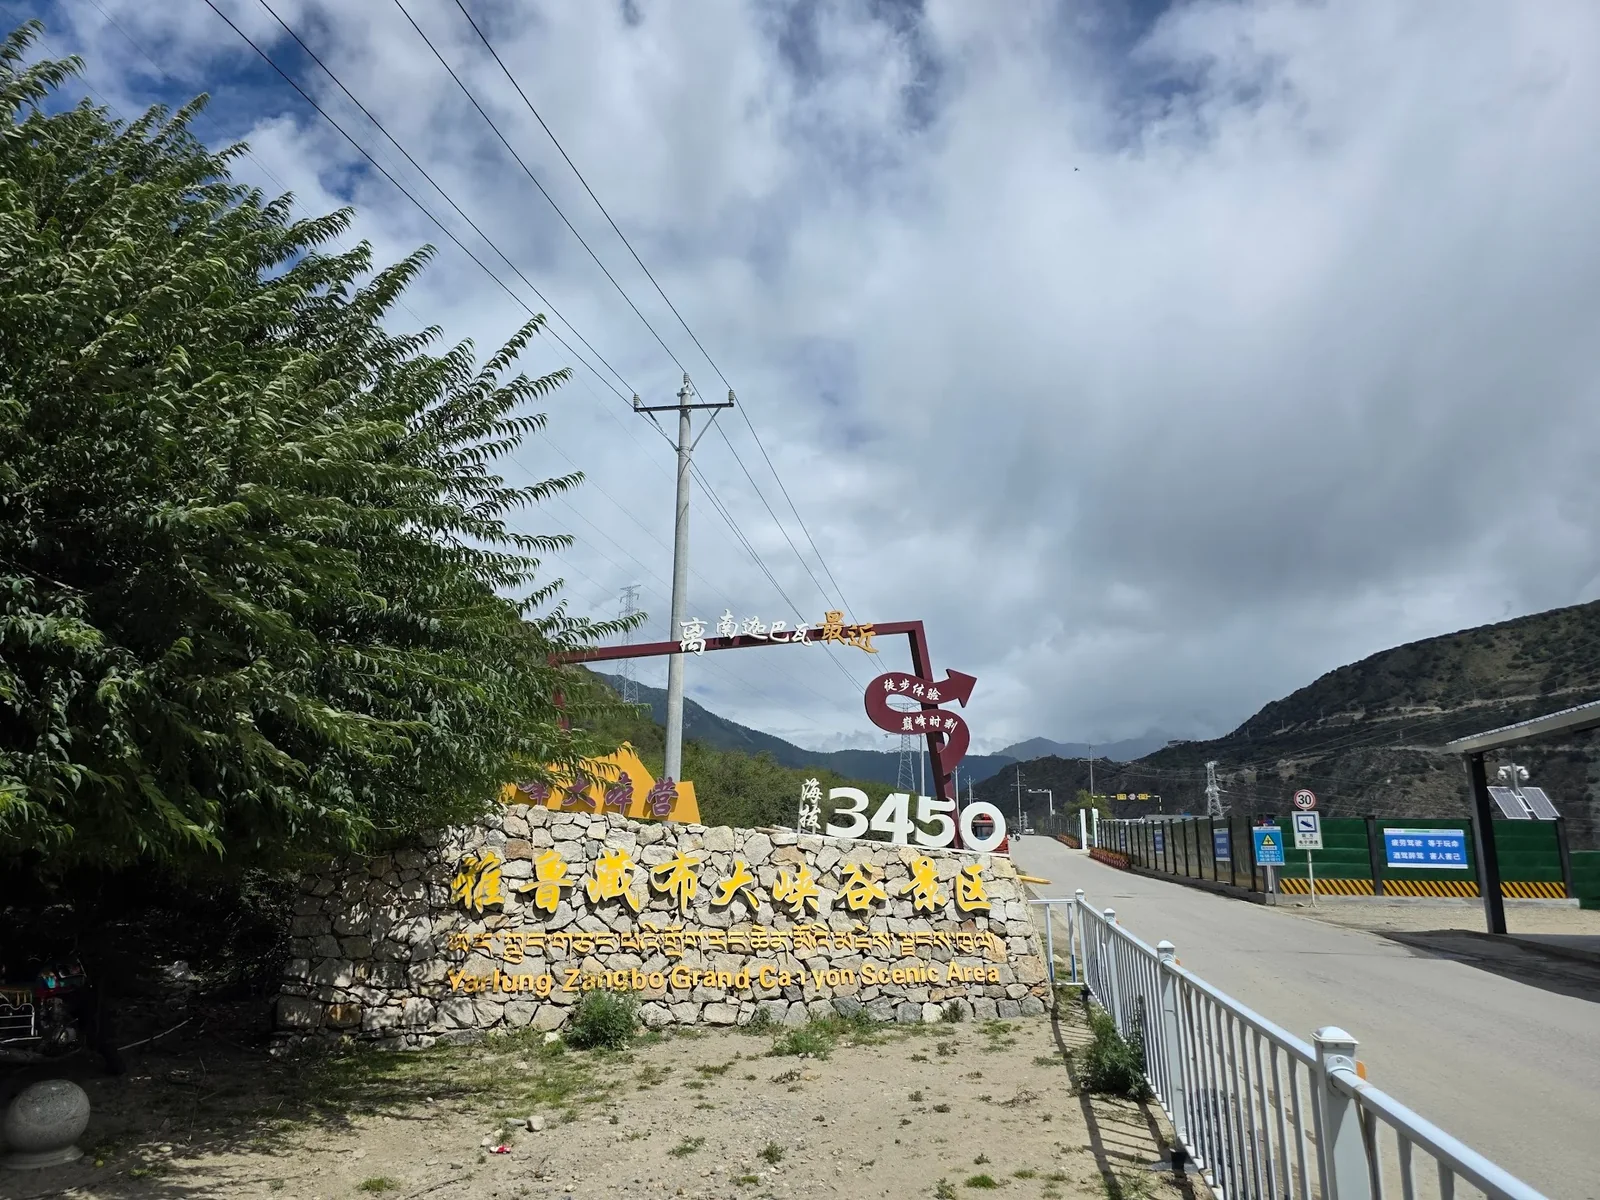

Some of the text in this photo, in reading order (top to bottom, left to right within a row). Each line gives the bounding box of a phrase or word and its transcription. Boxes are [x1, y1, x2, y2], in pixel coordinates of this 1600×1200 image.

[678, 609, 879, 656] 离南迦巴瓦最近
[884, 678, 942, 700] 徒步体验
[901, 714, 958, 733] 巅峰时刻
[799, 777, 823, 830] 海拔
[1297, 794, 1312, 805] 30
[825, 786, 1007, 852] 3450
[1391, 839, 1459, 848] 疲劳驾驶 等于玩命
[1429, 852, 1461, 861] 害人害己
[450, 848, 992, 914] 雅鲁藏布大峡谷景区
[447, 967, 552, 997] Yarlung
[562, 967, 665, 992] Zangbo
[671, 965, 750, 989] Grand
[861, 962, 940, 986] Scenic
[946, 961, 1000, 984] Area
